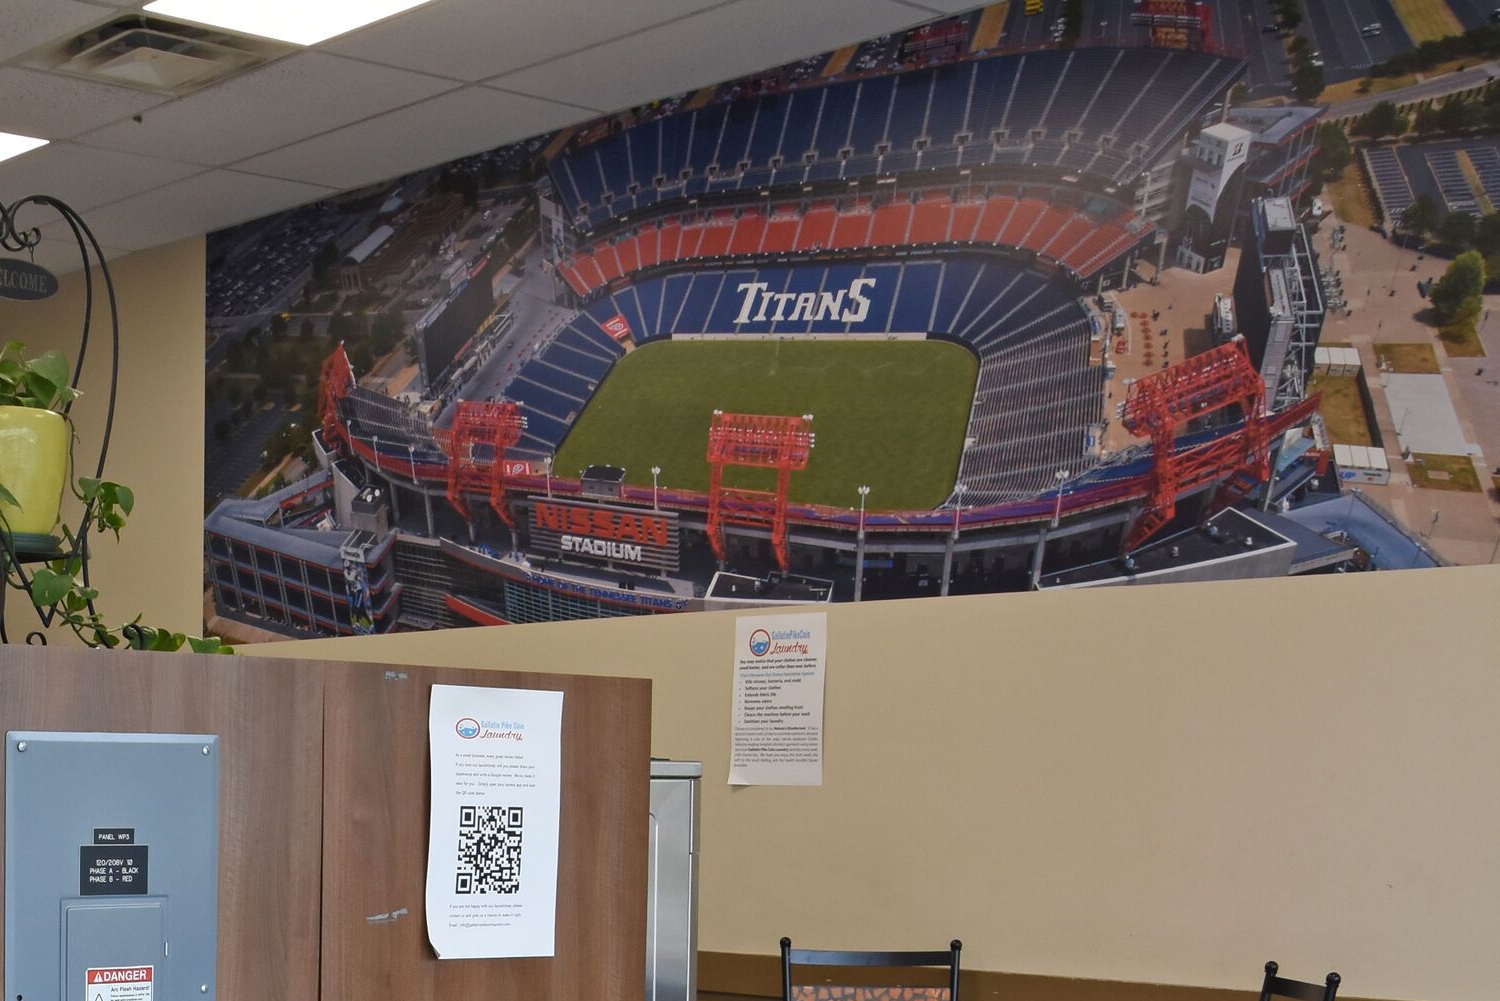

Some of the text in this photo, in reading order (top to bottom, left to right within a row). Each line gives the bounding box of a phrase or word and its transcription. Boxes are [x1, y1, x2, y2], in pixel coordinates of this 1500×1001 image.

[733, 278, 876, 324] TITANS
[535, 502, 668, 546] NISSAN
[560, 535, 642, 562] STADIUM
[640, 596, 672, 608] TITANS
[104, 970, 146, 982] DANGER
